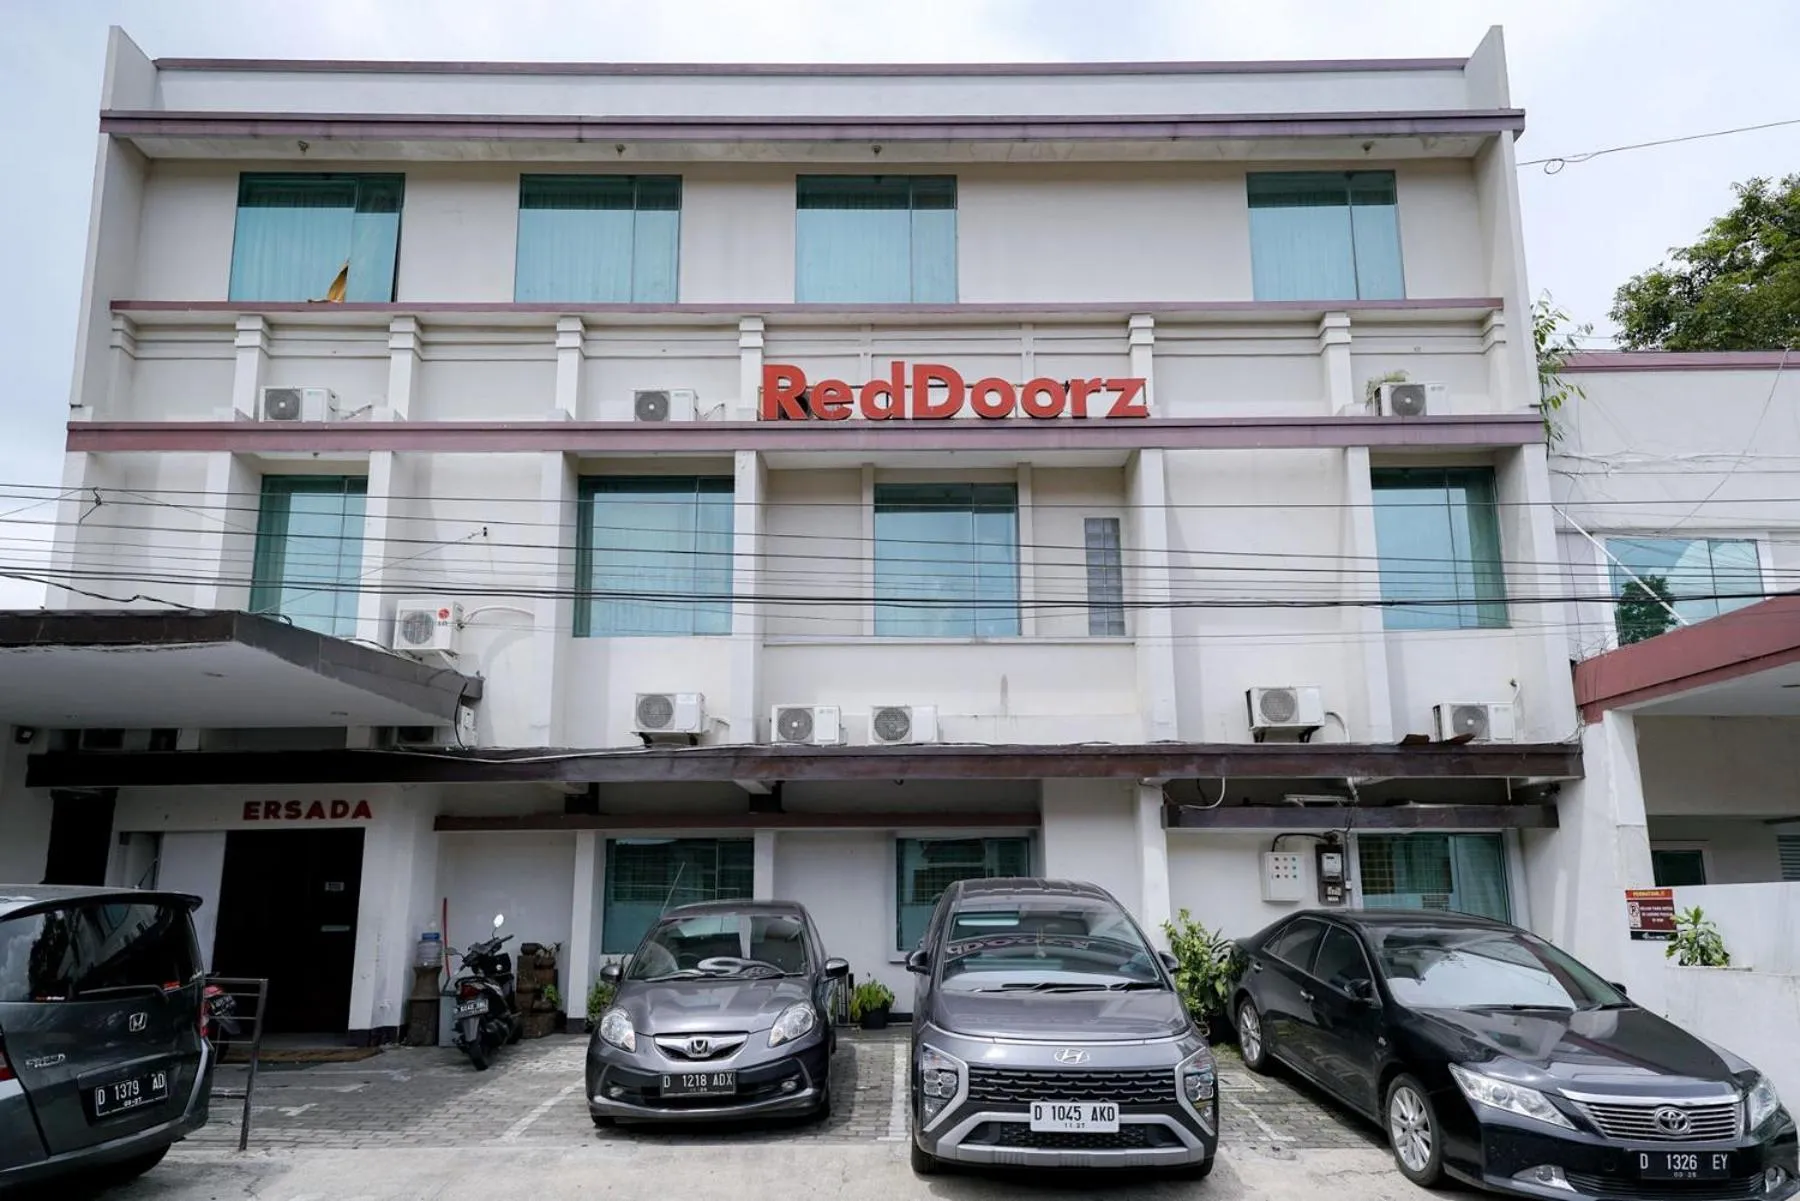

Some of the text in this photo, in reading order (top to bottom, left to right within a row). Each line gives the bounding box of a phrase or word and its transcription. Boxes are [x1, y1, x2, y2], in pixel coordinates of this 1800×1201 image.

[763, 361, 1148, 421] RedDoorz
[243, 799, 372, 820] ERSADA
[98, 1073, 165, 1106] D 1379 AD
[664, 1073, 733, 1088] D 1218 ADX
[1034, 1105, 1115, 1122] D 1045 AKD
[1640, 1153, 1728, 1170] D 1326 EY
